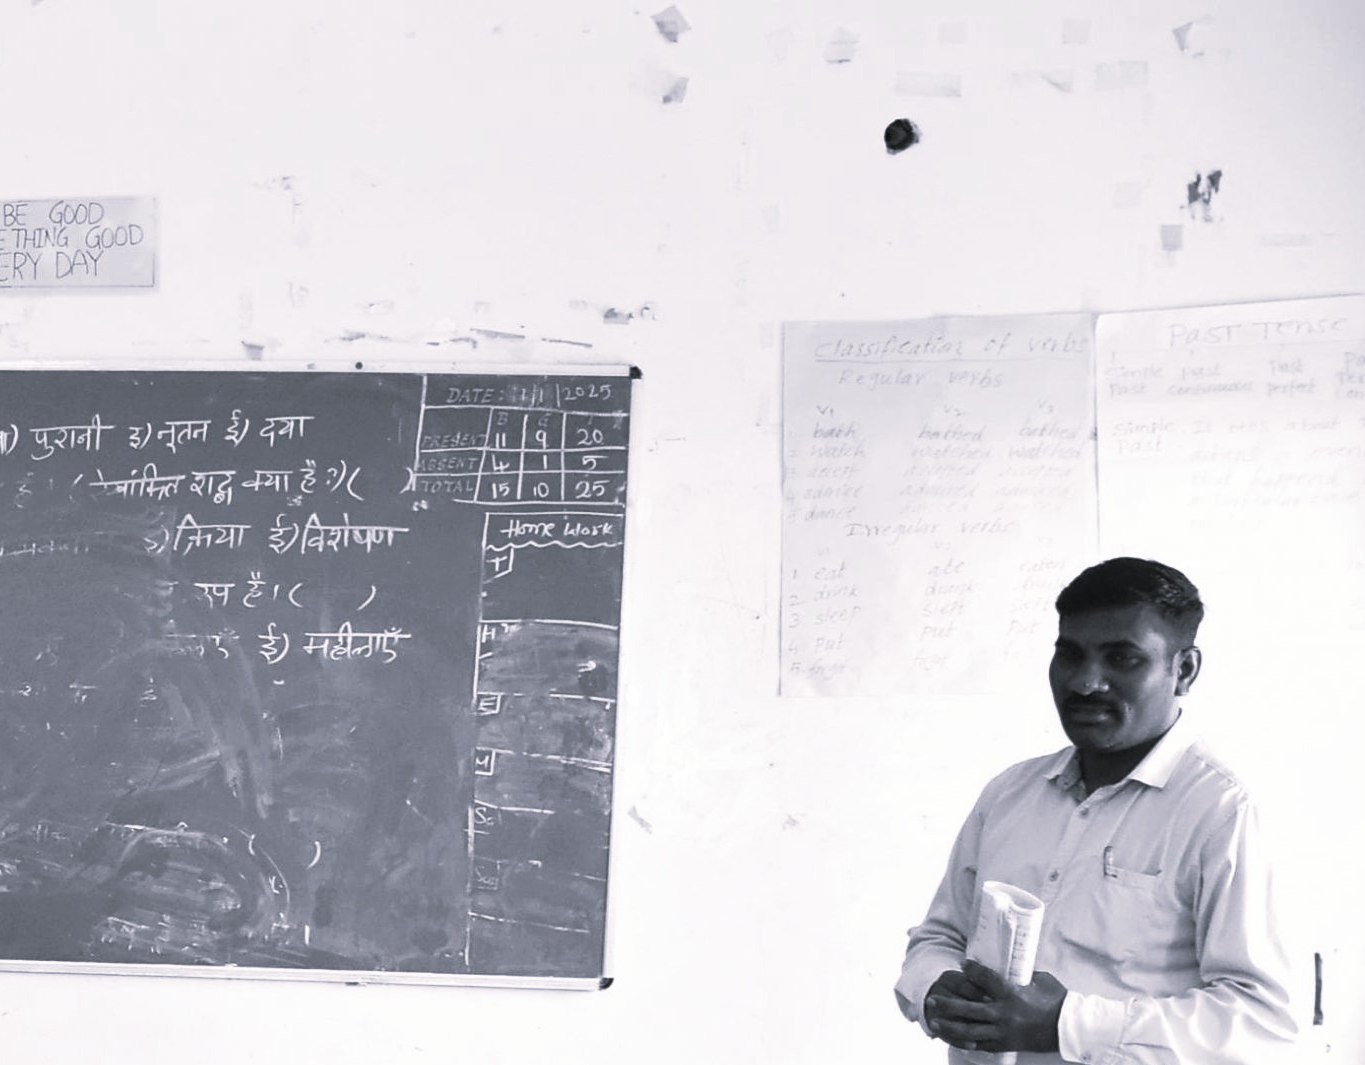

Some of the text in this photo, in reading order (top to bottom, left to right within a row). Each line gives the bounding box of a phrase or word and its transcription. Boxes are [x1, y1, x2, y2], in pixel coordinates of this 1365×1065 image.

[3, 203, 28, 227] BE
[49, 201, 105, 225] GOOD
[86, 224, 144, 249] GOOD
[55, 249, 105, 279] DAY
[814, 335, 964, 359] Classification
[983, 331, 1013, 358] of
[838, 367, 927, 391] Regular
[535, 430, 547, 449] 9
[577, 428, 603, 446] 20
[492, 454, 510, 473] 4
[581, 455, 609, 470] 5
[421, 480, 610, 499] TOTAL 15 10 25
[500, 519, 553, 538] Home
